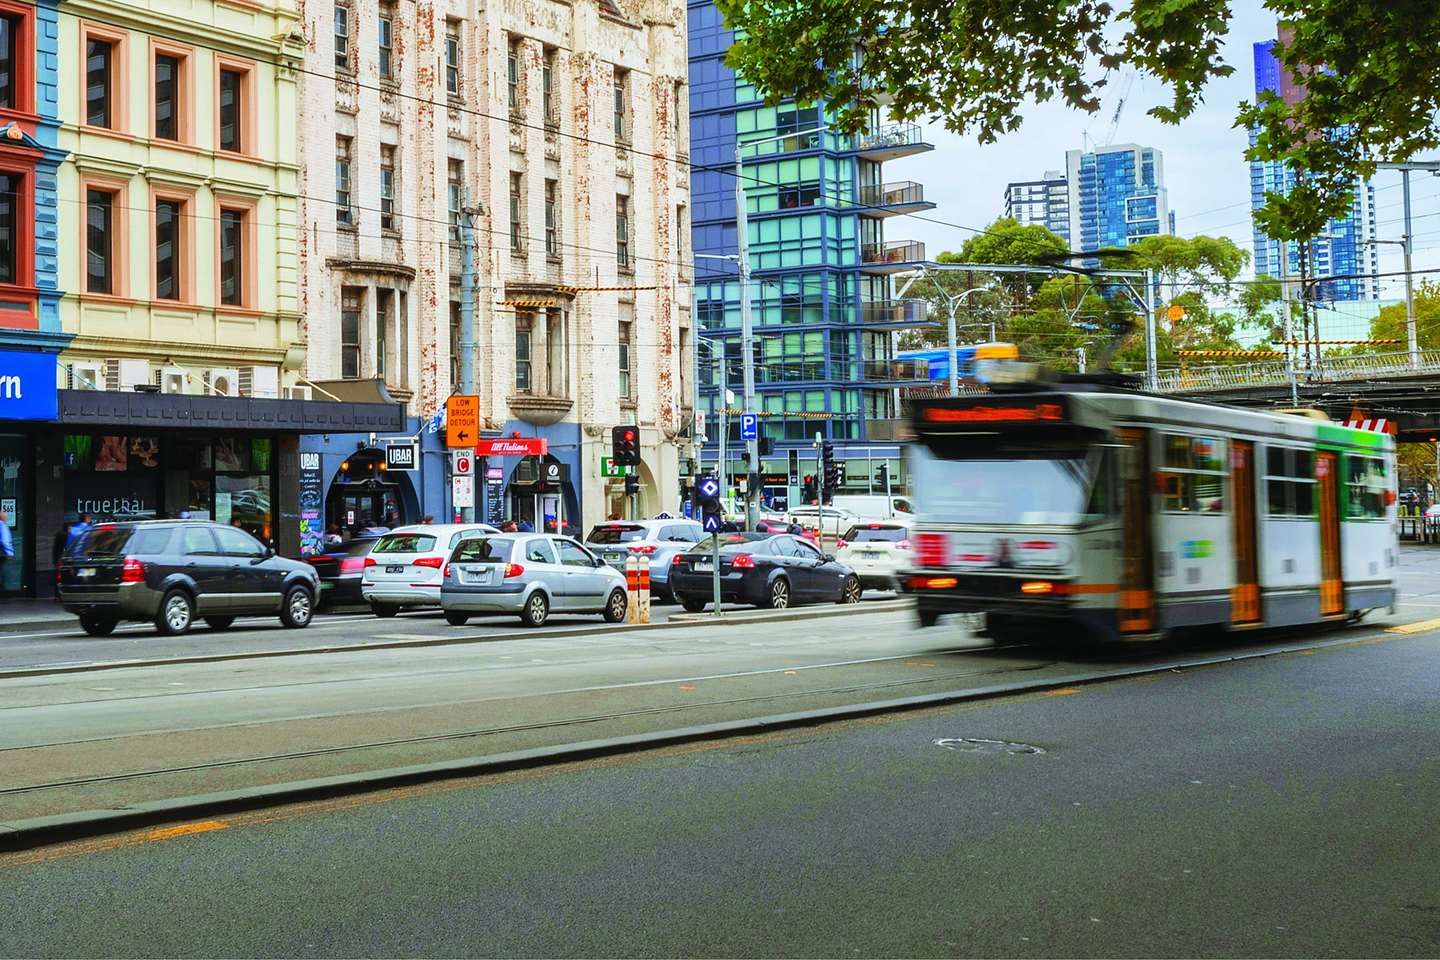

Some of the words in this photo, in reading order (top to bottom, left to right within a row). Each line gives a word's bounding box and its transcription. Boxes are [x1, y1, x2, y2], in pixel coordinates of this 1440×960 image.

[456, 399, 470, 407] LOW
[451, 408, 475, 417] BRIDGE
[450, 418, 475, 427] DETOUR
[743, 416, 754, 430] P
[300, 453, 320, 470] UBAR
[389, 448, 412, 464] UBAR
[458, 458, 468, 472] C
